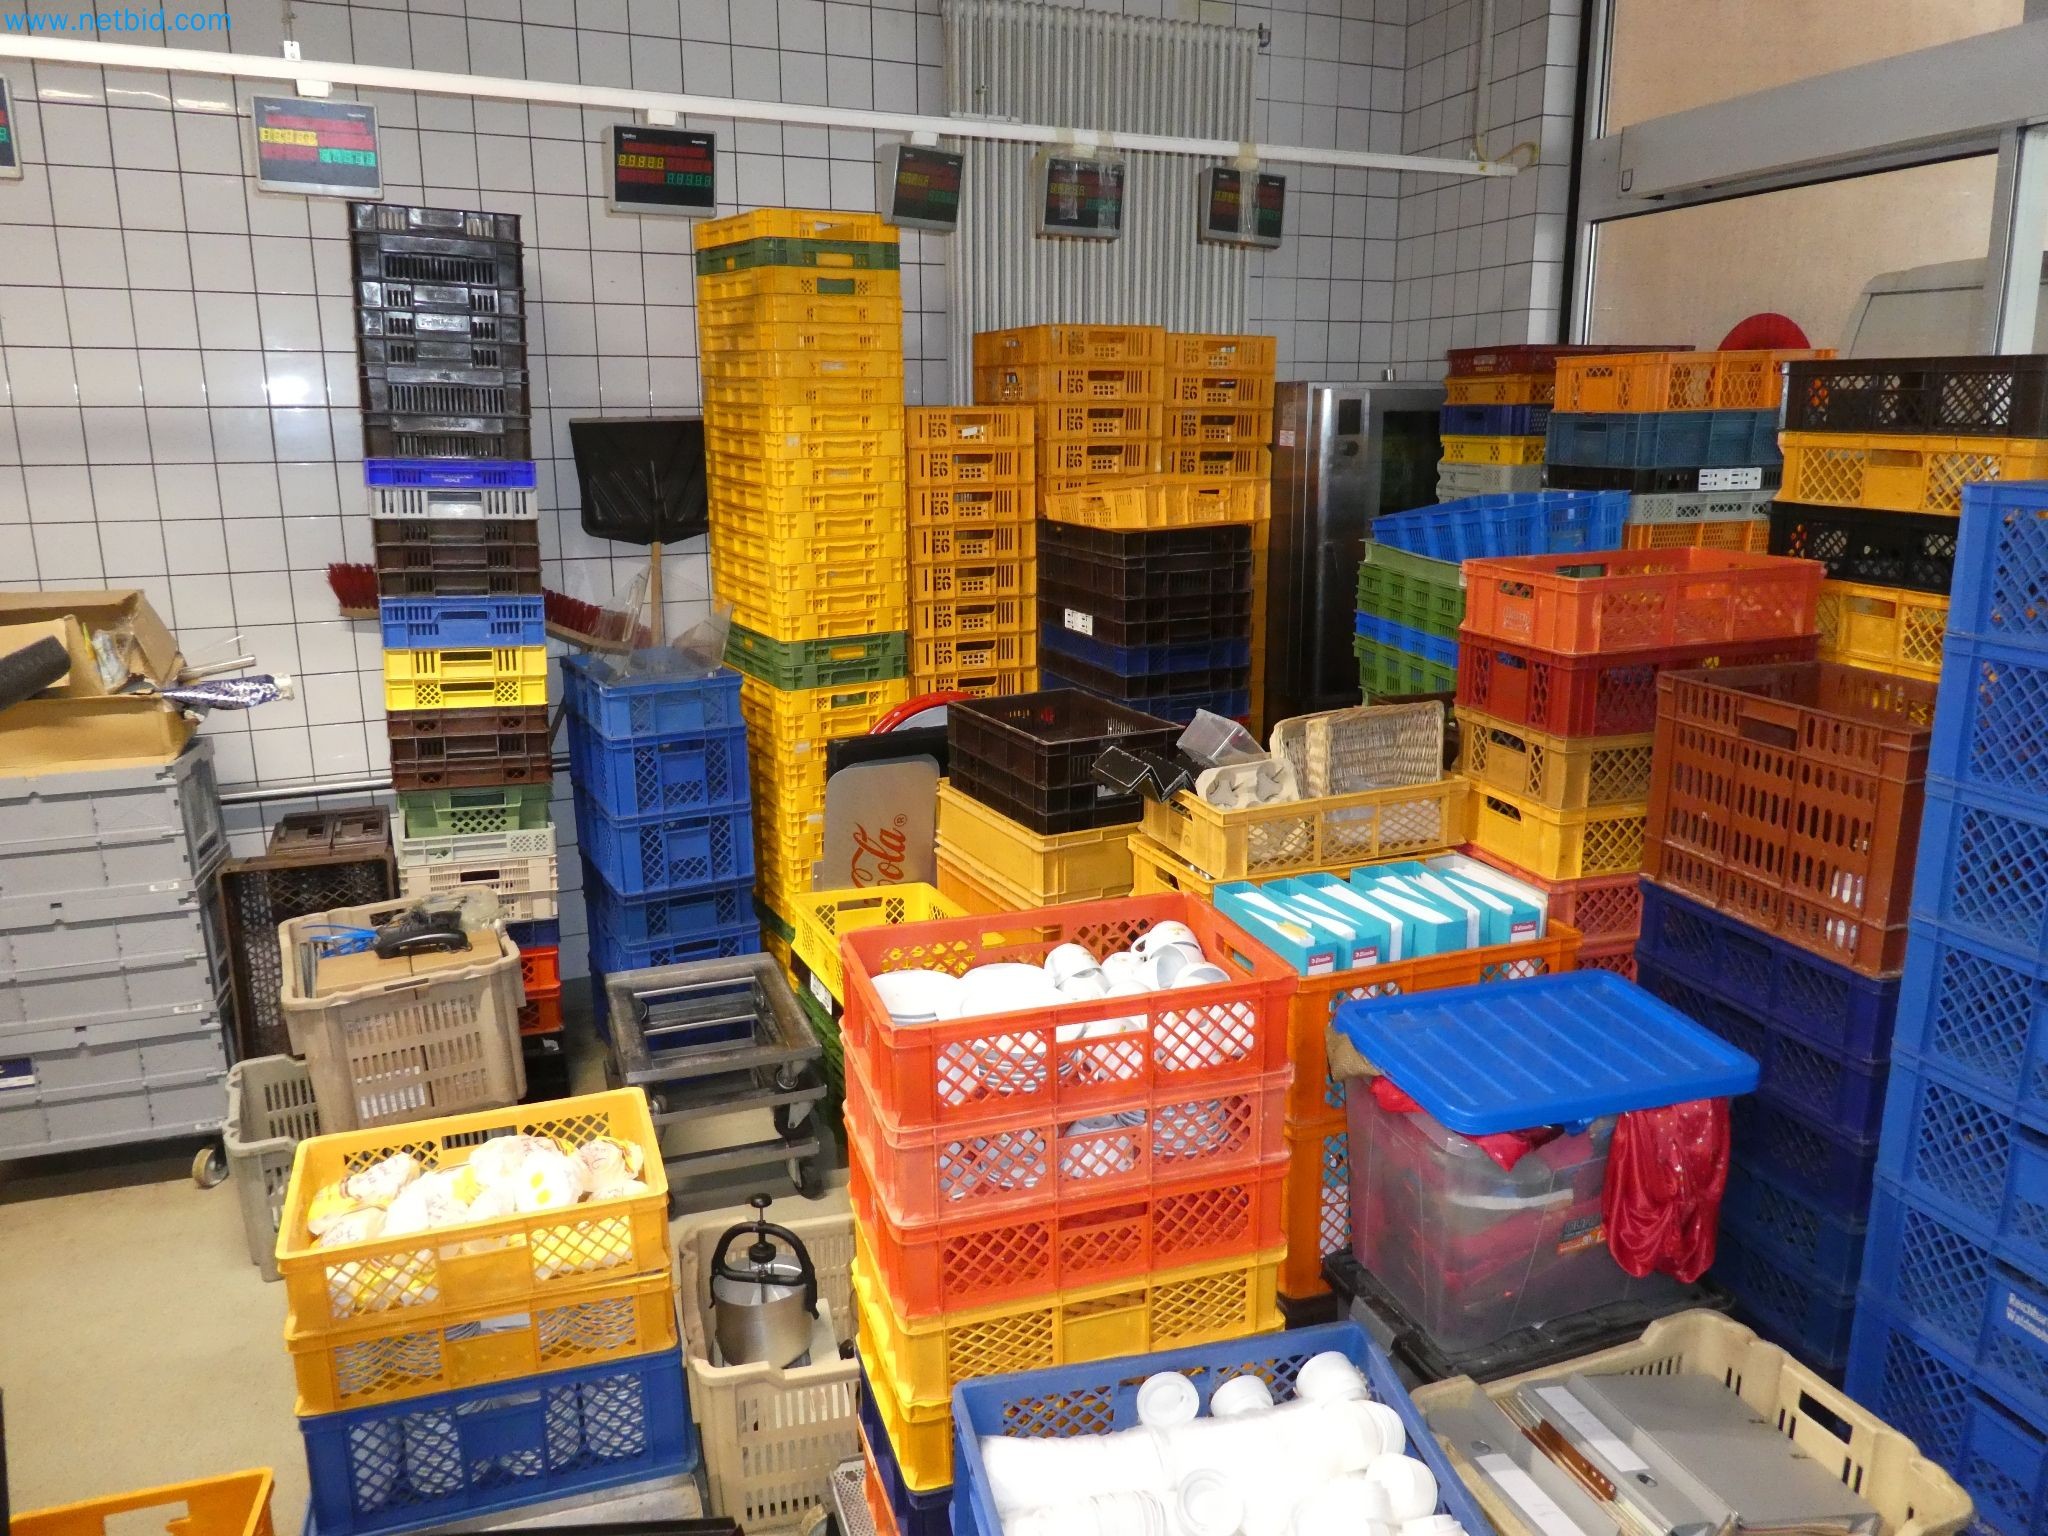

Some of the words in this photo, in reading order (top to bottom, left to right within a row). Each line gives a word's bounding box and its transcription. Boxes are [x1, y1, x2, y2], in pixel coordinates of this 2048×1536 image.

[1067, 378, 1083, 394] E6
[1182, 384, 1198, 400] E6
[928, 422, 947, 438] E6
[1066, 416, 1083, 431] E6
[1181, 421, 1197, 436] E6
[1066, 453, 1082, 468] E6
[1180, 458, 1196, 474] E6
[930, 462, 948, 477] E6
[931, 500, 949, 516] E6
[932, 538, 950, 554] E6
[934, 576, 952, 592] E6
[934, 613, 952, 628] E6
[934, 650, 952, 665] E6
